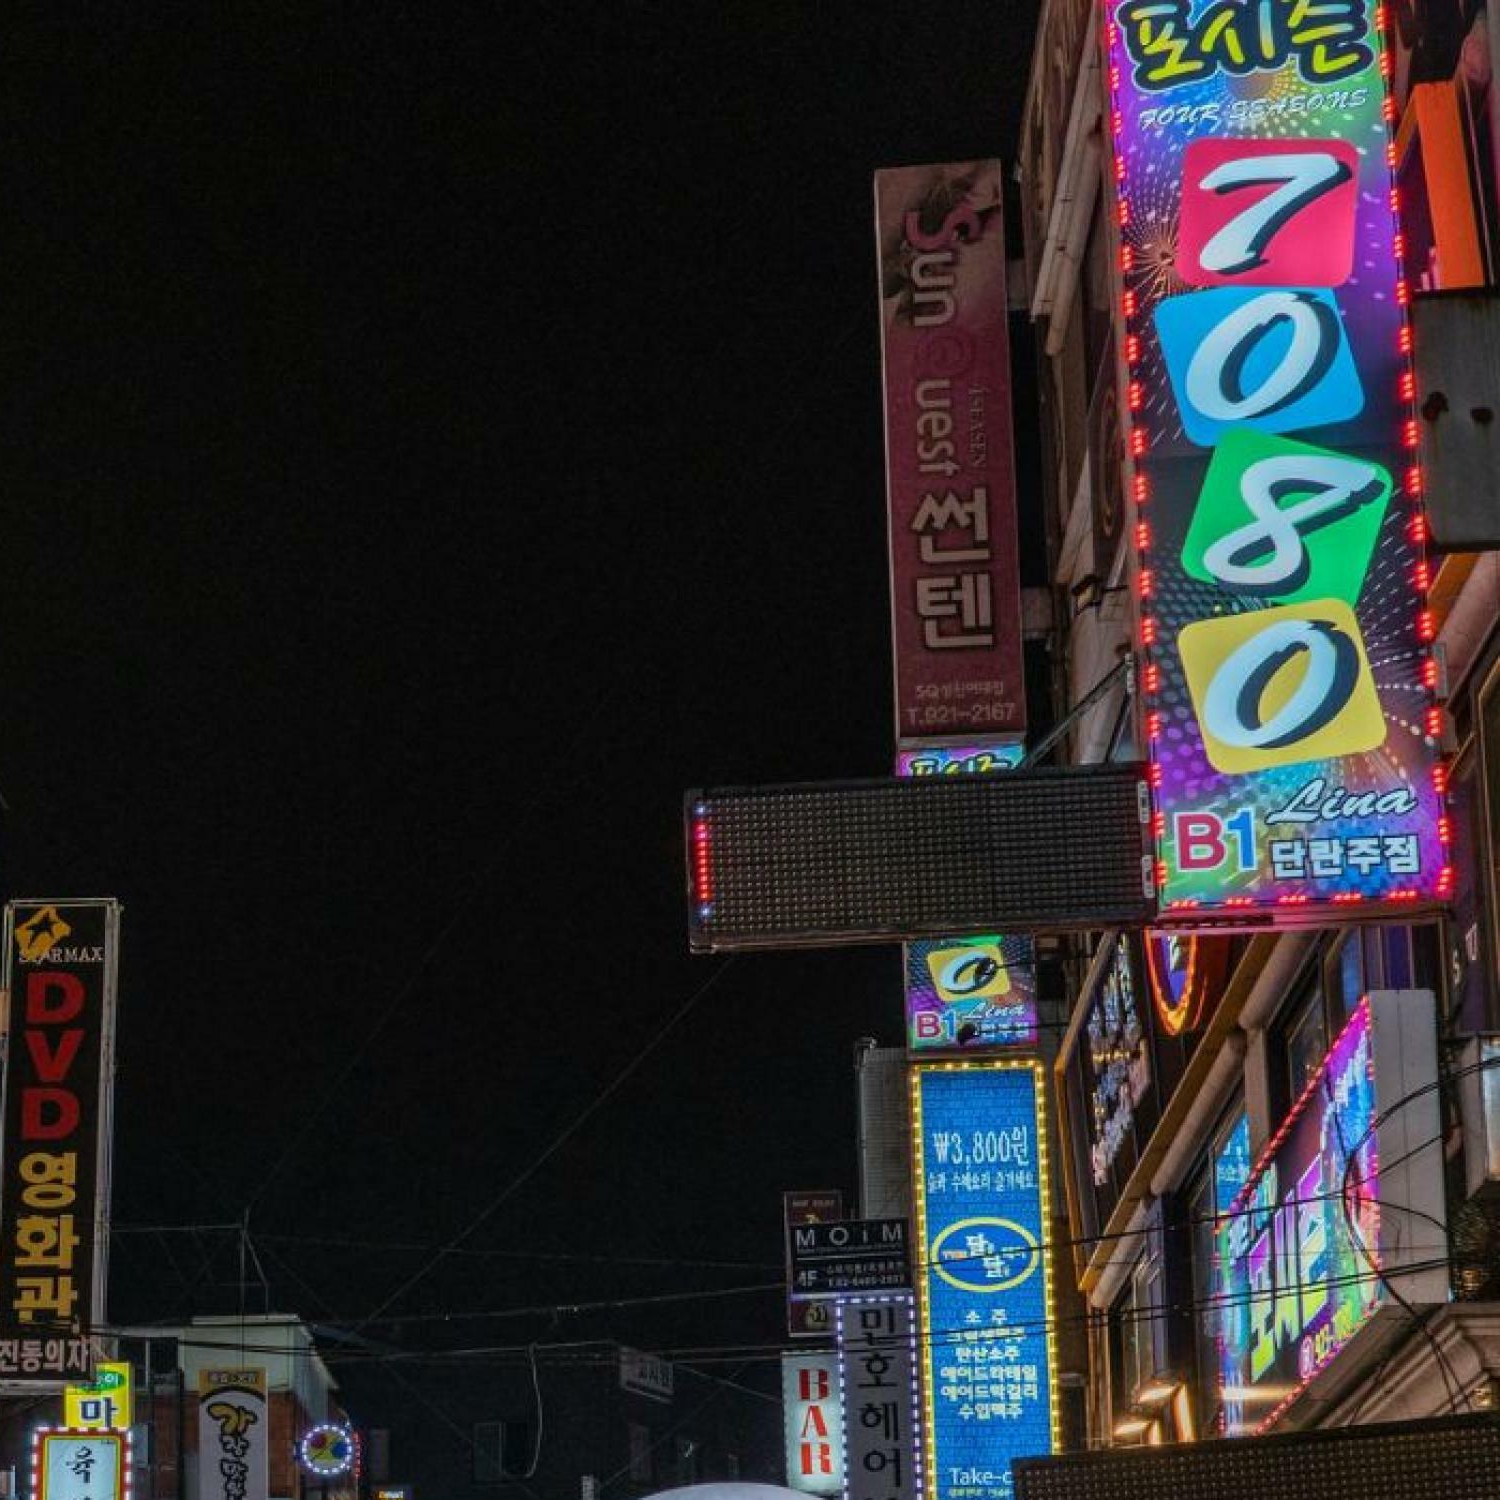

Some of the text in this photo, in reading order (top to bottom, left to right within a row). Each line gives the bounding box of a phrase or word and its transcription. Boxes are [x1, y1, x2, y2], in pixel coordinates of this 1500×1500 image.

[1140, 90, 1368, 128] FOUR SEASONS
[1266, 779, 1418, 823] Lina
[1175, 806, 1259, 872] B1
[1270, 834, 1422, 880] 단란주점
[915, 1011, 958, 1042] B1
[19, 971, 85, 1140] DVD
[12, 1151, 80, 1325] 영화관
[0, 1338, 92, 1373] 진동의자
[799, 1369, 834, 1476] BAR
[859, 1305, 899, 1488] 민호헤어
